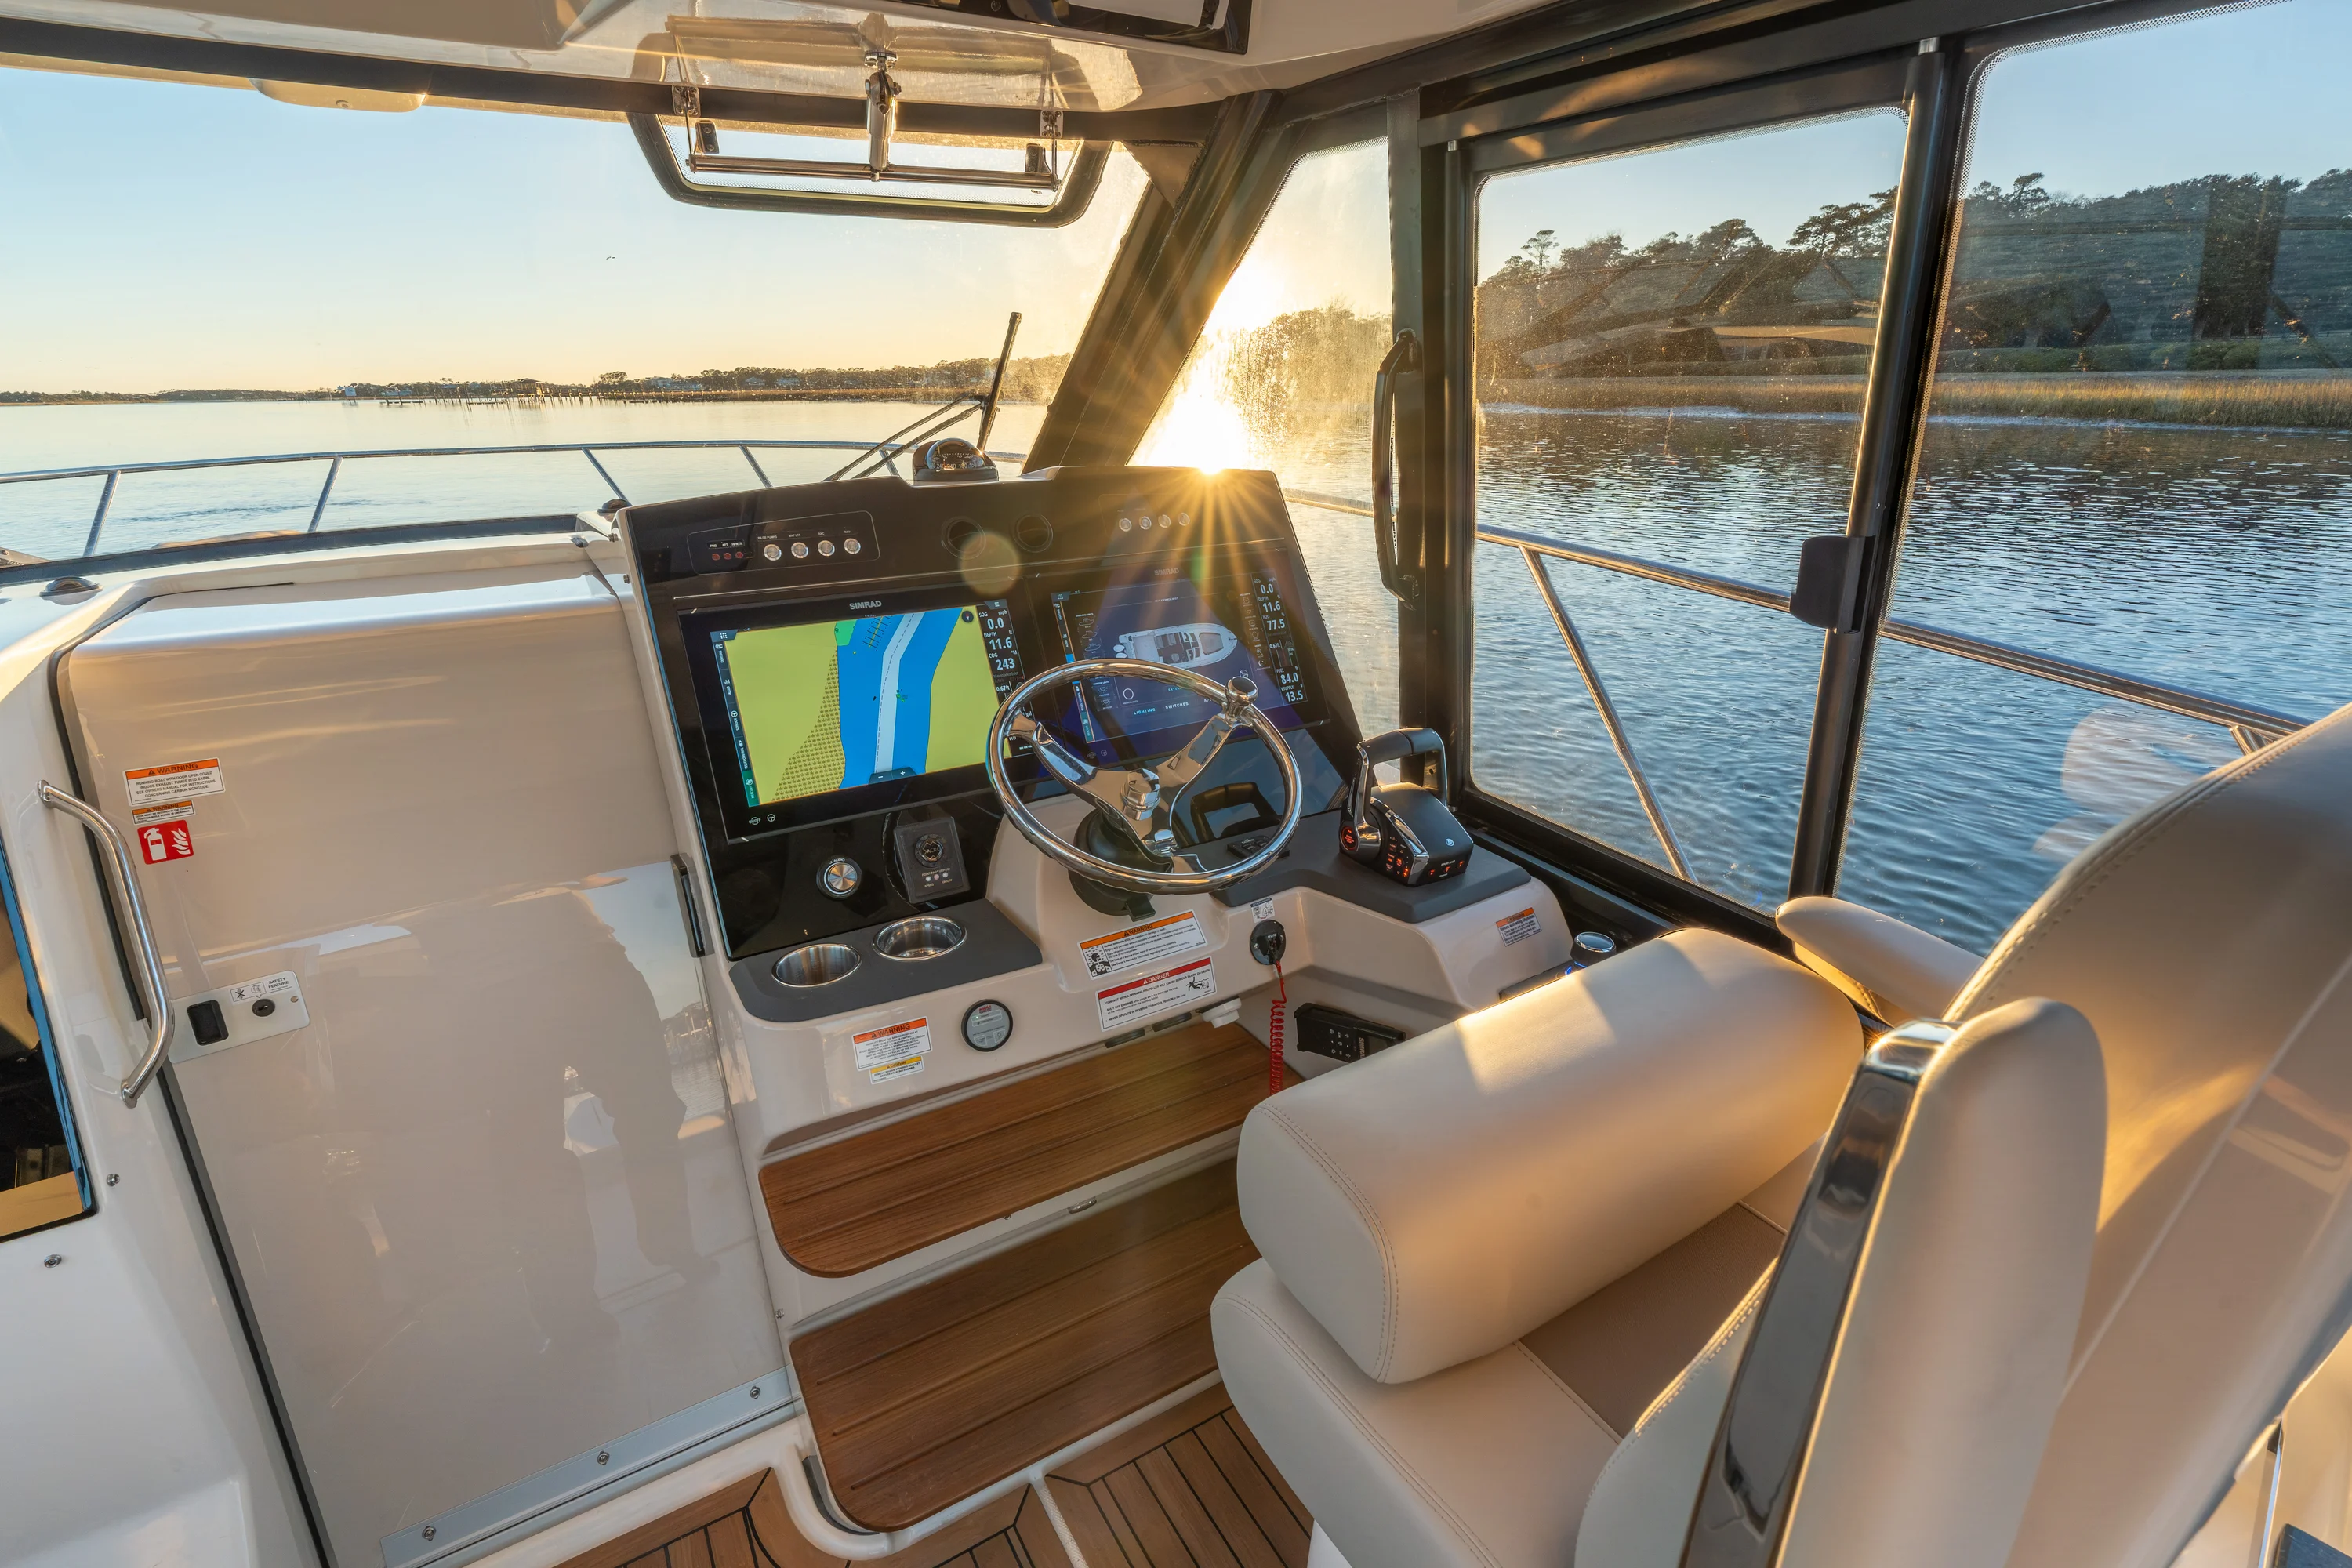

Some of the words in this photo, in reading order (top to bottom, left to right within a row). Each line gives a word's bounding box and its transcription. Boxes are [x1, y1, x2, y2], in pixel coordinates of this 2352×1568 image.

[1154, 568, 1180, 576] SIMRAD
[1260, 583, 1274, 594] 0.0
[849, 600, 882, 610] SIMRAD
[1263, 601, 1281, 612] 11.6
[987, 617, 1004, 630] 0.0
[1267, 619, 1286, 630] 77.5
[989, 637, 1012, 650] 11.6
[996, 658, 1015, 671] 243
[1280, 673, 1299, 684] 84.0
[1286, 690, 1304, 702] 13.5
[157, 763, 198, 774] WARNING
[1127, 923, 1153, 935] WARNING
[1148, 971, 1170, 982] DANGER
[877, 1023, 910, 1036] WARNING
